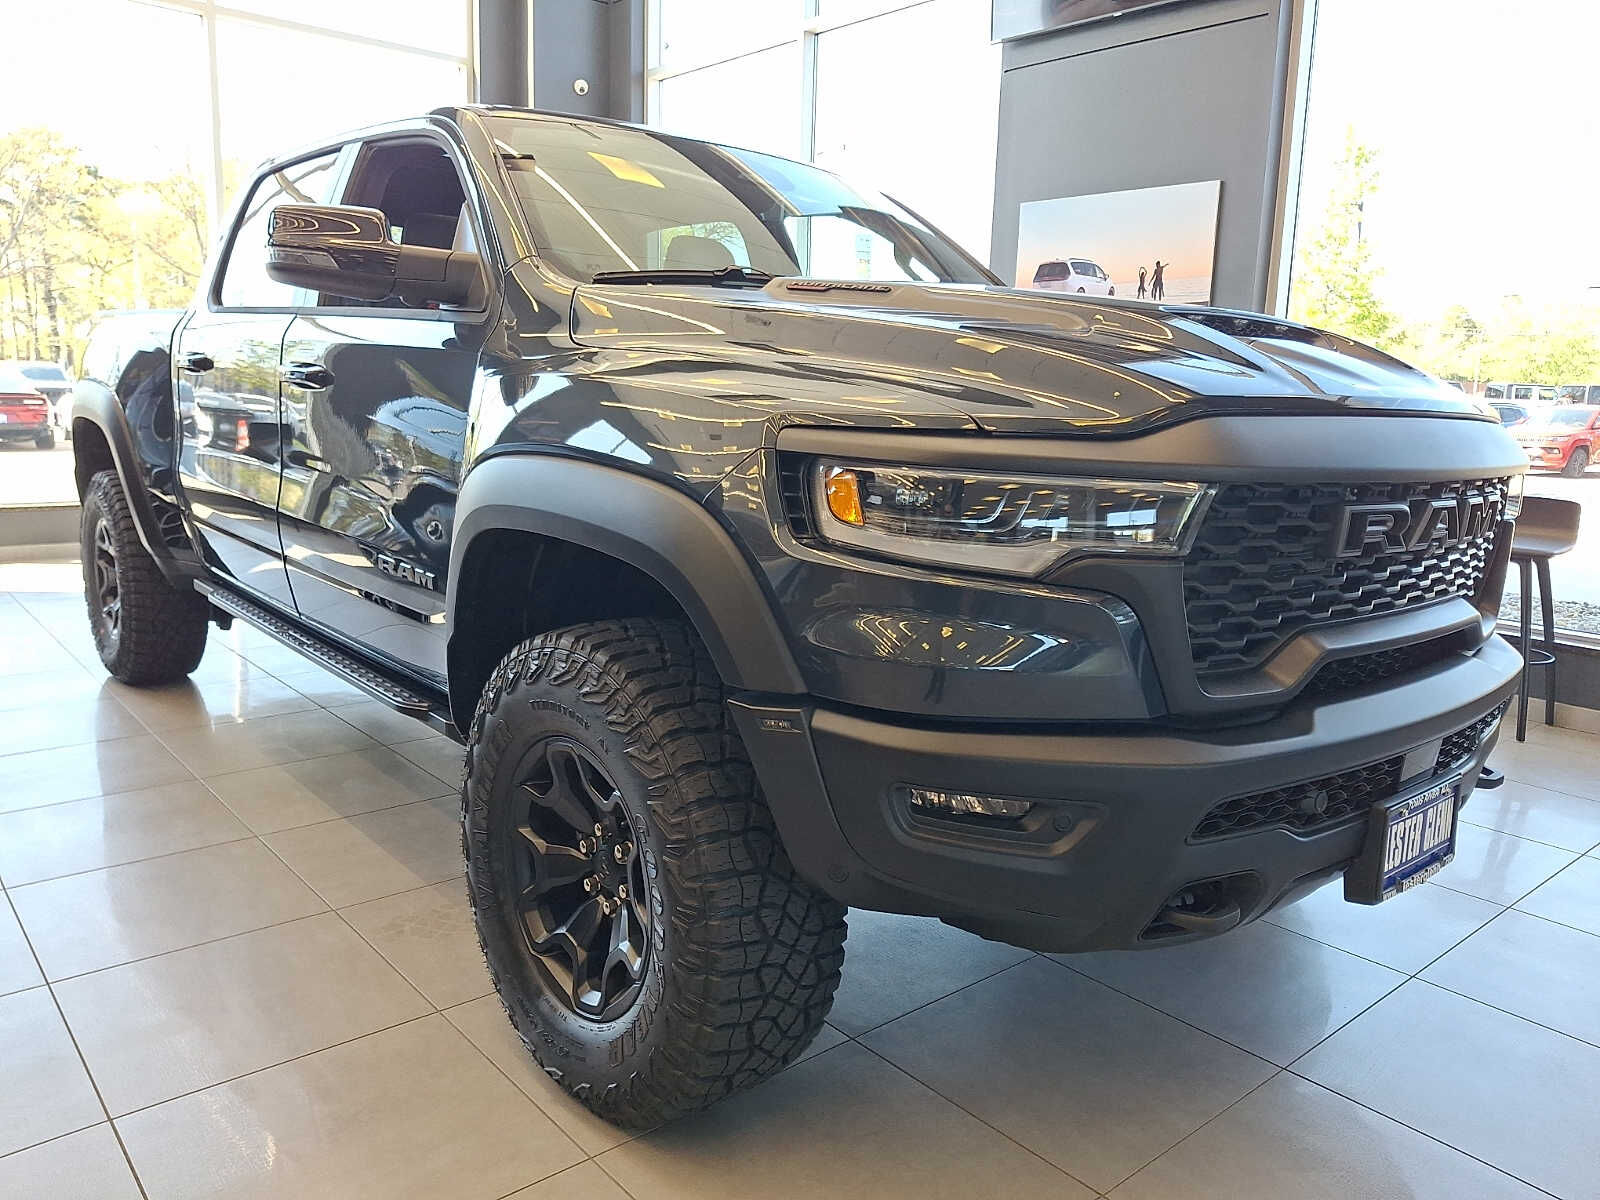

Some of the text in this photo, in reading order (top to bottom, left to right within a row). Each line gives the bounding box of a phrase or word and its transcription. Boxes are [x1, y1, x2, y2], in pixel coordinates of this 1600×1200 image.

[1337, 497, 1501, 557] RAM
[377, 553, 435, 591] RAM
[1384, 797, 1455, 873] LESTER GLENN
